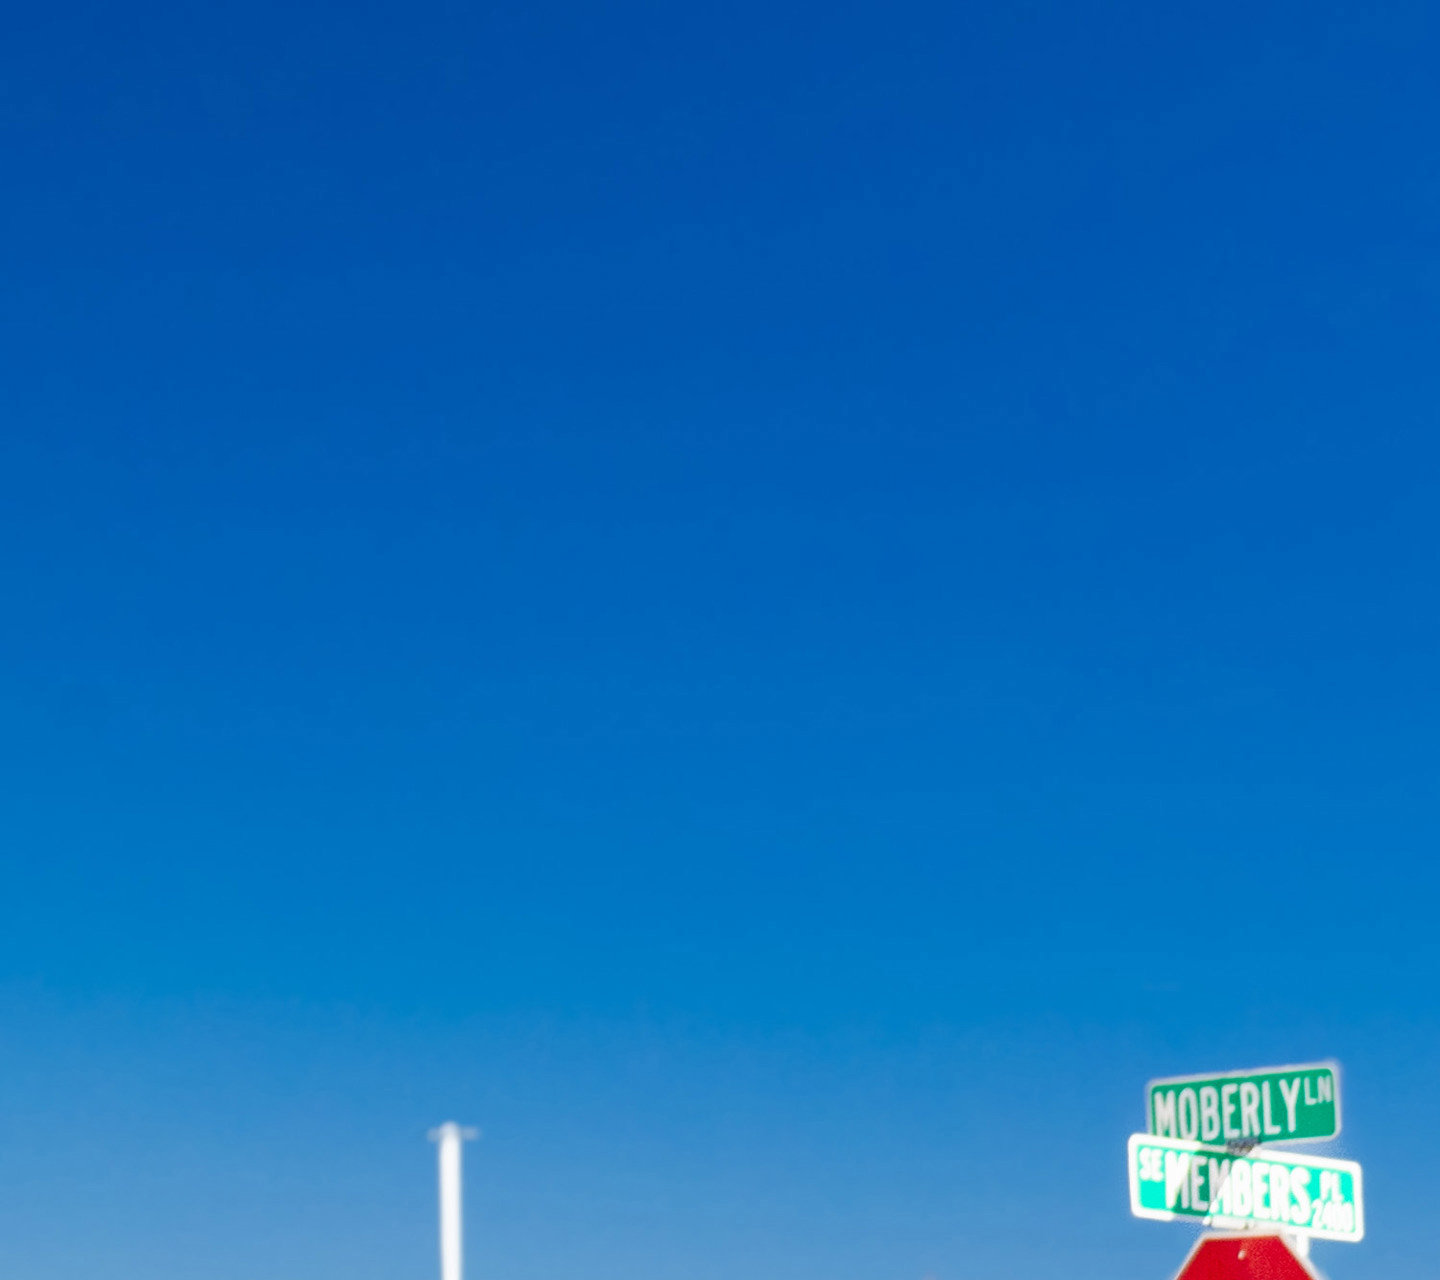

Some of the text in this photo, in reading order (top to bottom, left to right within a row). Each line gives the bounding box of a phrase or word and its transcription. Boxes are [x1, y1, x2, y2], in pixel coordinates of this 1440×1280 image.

[1153, 1075, 1333, 1142] MOBERLY LN
[1139, 1147, 1343, 1224] SE MEMBERS PL
